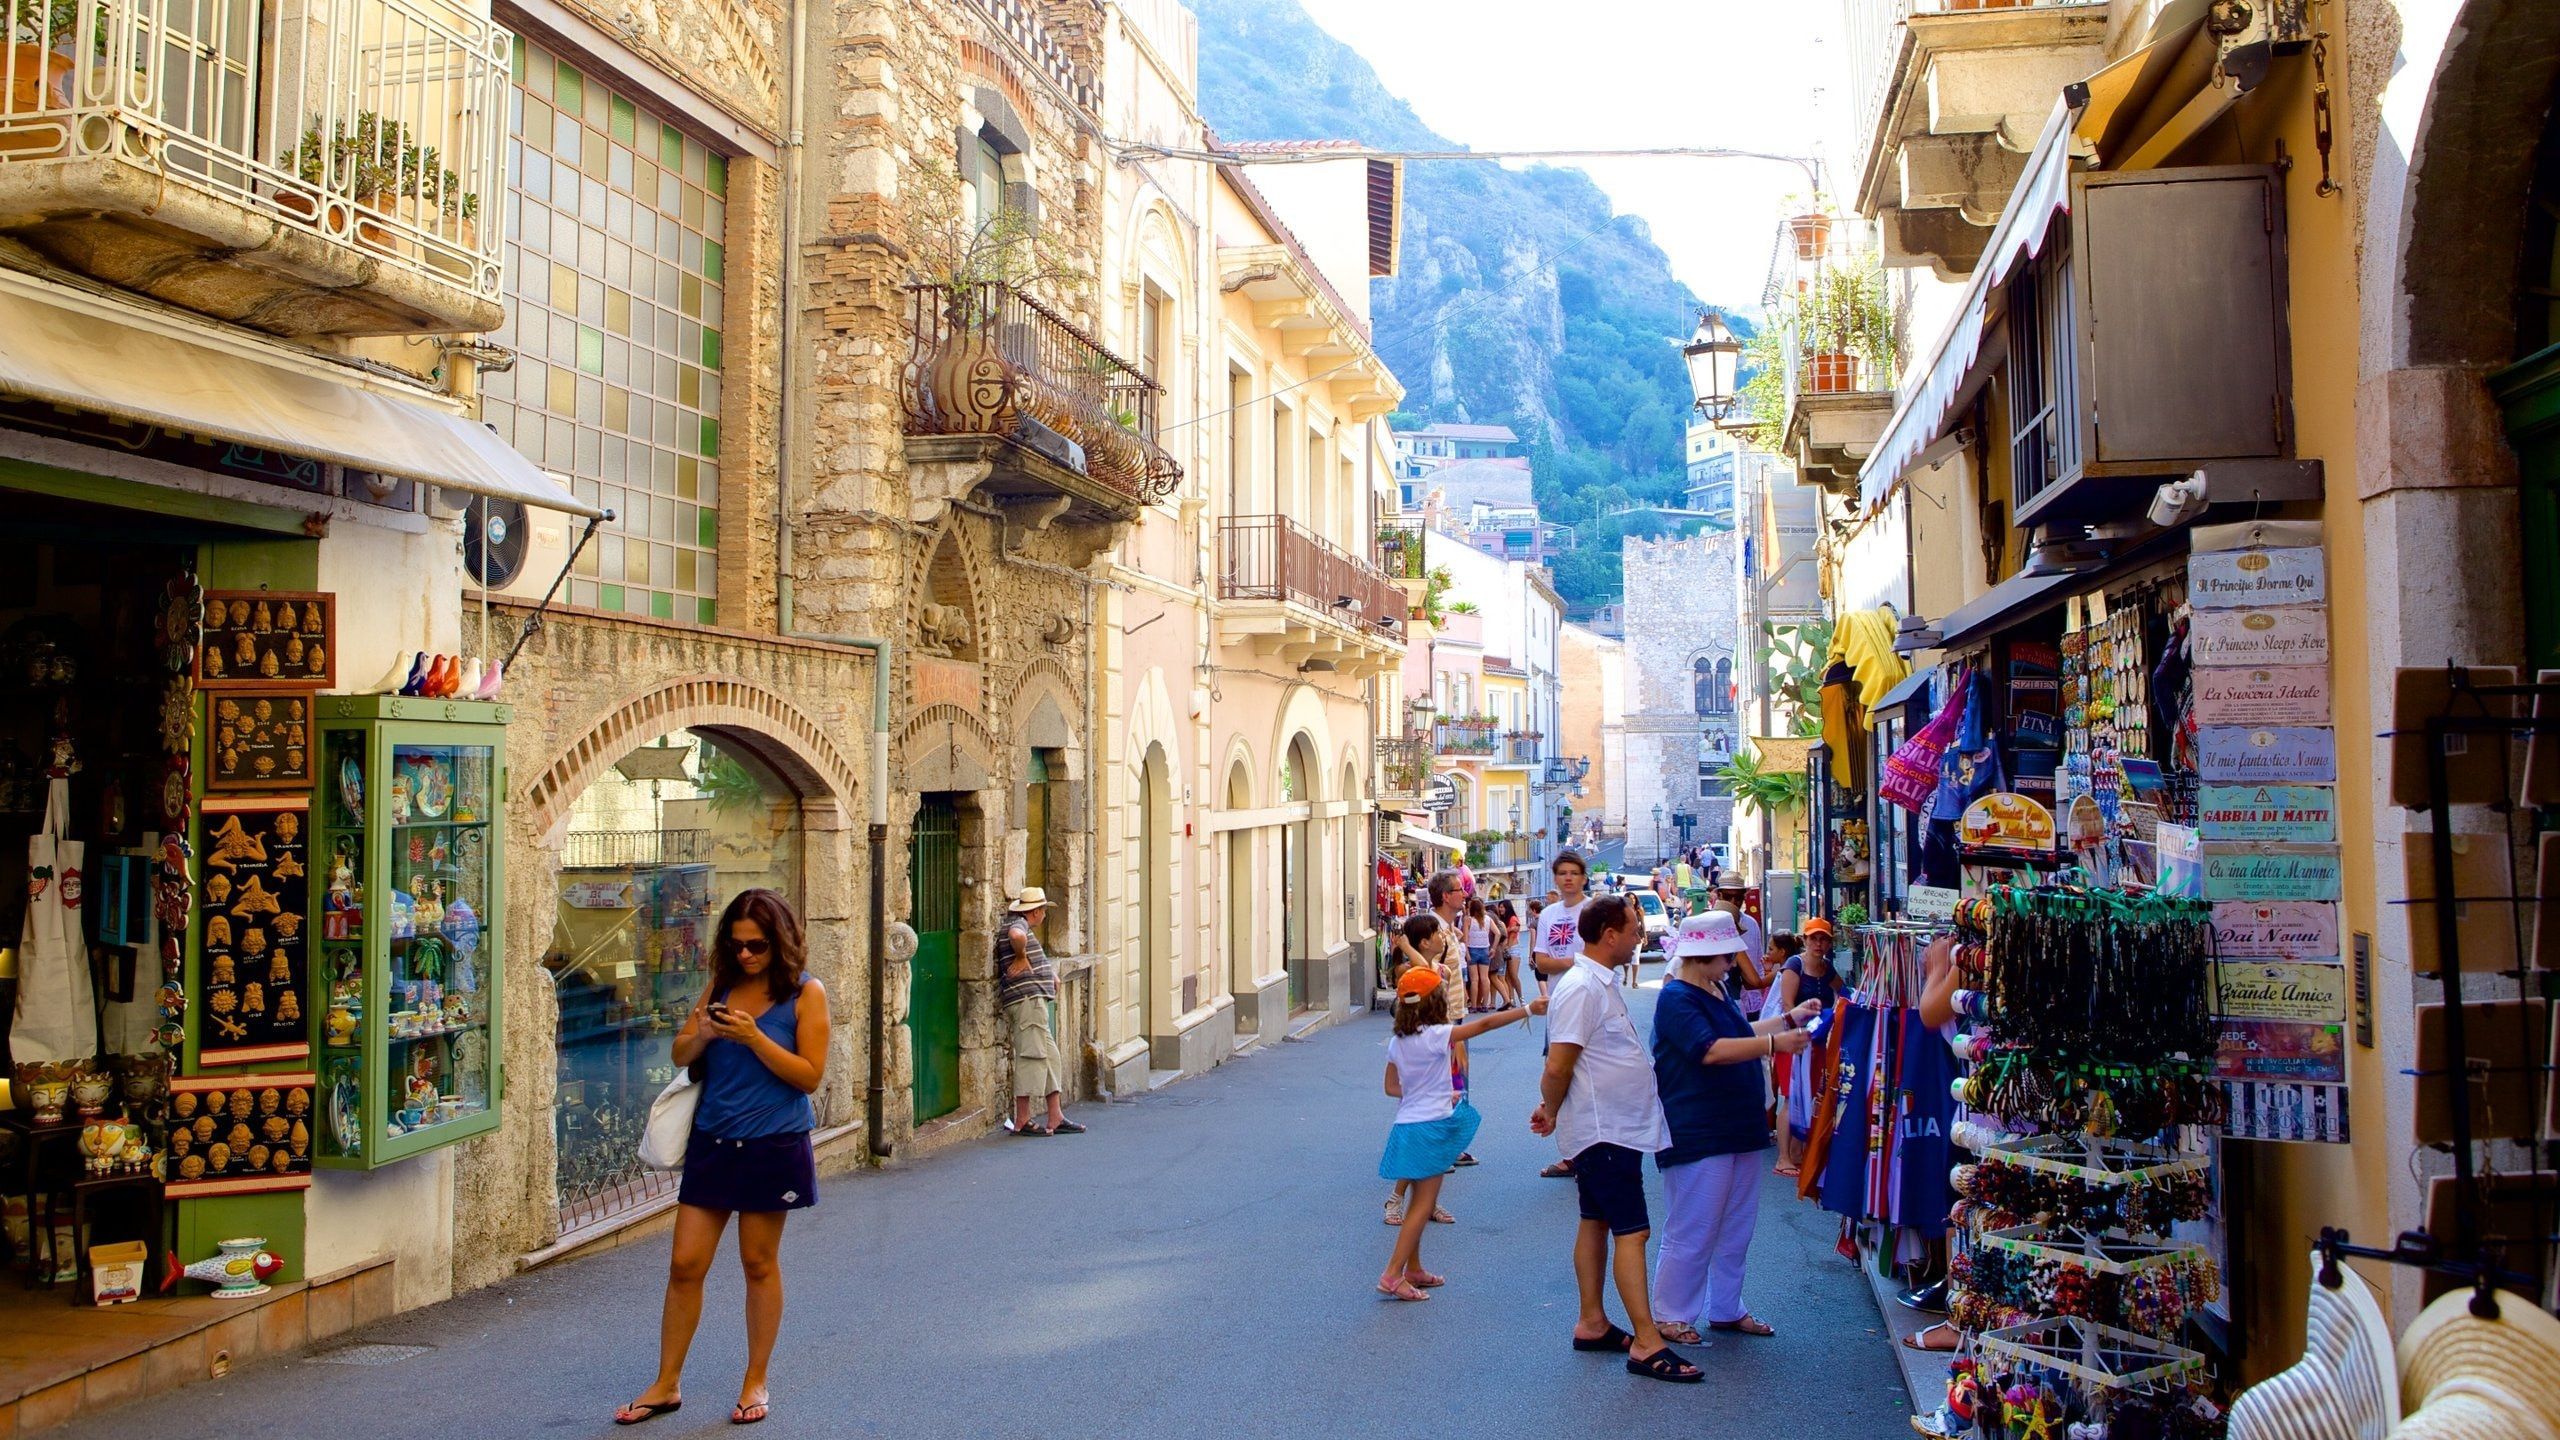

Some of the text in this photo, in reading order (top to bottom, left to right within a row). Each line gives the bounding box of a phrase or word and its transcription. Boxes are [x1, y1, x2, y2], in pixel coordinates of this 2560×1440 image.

[2197, 574, 2314, 596] Il Principe Dorme Qui
[2216, 636, 2258, 651] Princess
[2262, 635, 2295, 653] Sleeps
[2299, 634, 2326, 649] Here
[2013, 681, 2056, 689] SIZILIEN
[2202, 685, 2320, 700] La Suocera Ideale
[2022, 715, 2052, 734] ETNA
[2203, 751, 2329, 772] Il mio fantastico Nonno
[2203, 809, 2329, 822] GABBIA DI MATTI
[2210, 860, 2335, 879] Cuina della Mamma
[2218, 929, 2322, 942] Dai Nonni
[2219, 983, 2333, 1002] Grande Amico
[2220, 1032, 2247, 1040] FEDE
